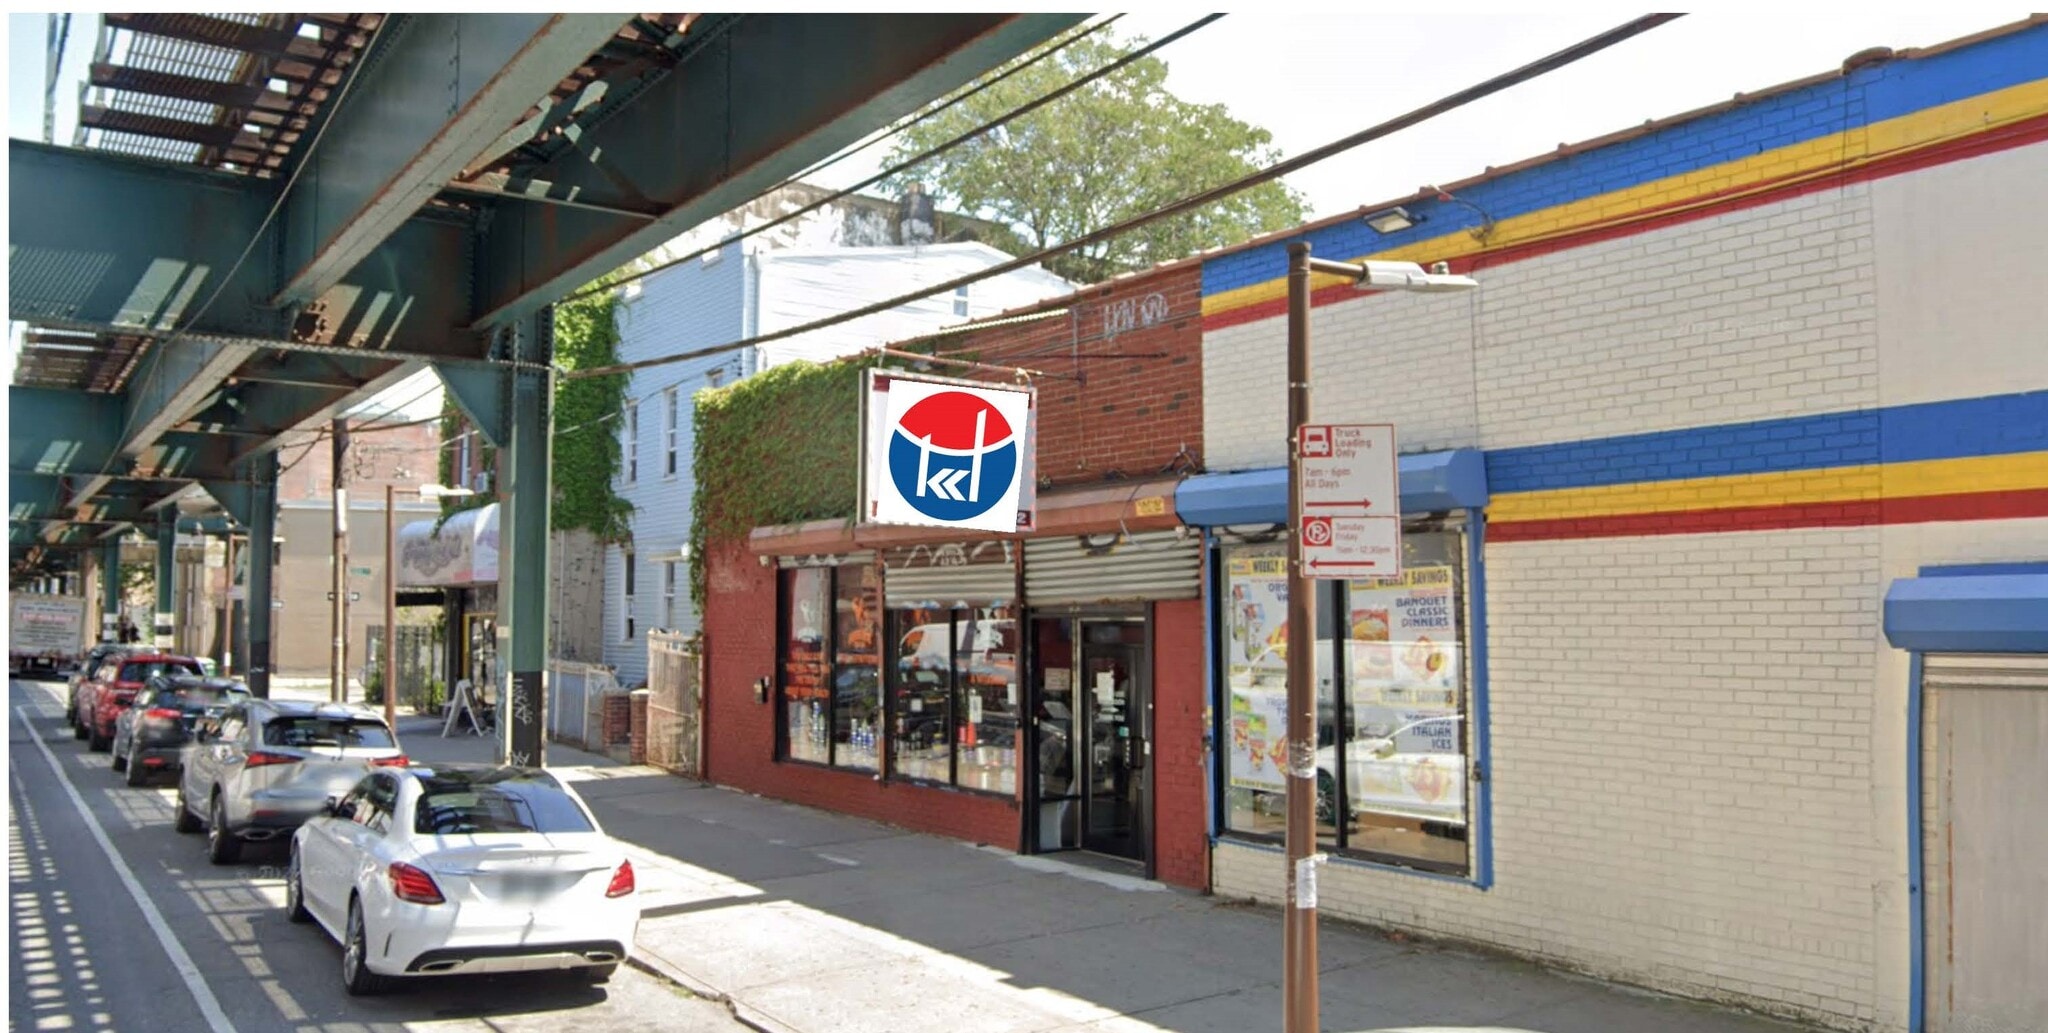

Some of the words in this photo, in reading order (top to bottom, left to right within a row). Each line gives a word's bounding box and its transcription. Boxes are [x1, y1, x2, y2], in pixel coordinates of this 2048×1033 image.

[1335, 429, 1361, 437] Truck
[1335, 439, 1372, 449] Loading
[1336, 449, 1357, 459] Only
[1305, 467, 1323, 477] 7am
[1331, 467, 1351, 478] 6pm
[1305, 480, 1317, 489] All
[1318, 480, 1340, 490] Days
[1411, 569, 1448, 585] SAVINGS
[1396, 596, 1448, 608] BANQUET
[1406, 607, 1449, 617] CLASSIC
[1402, 617, 1449, 628] DINNERS
[1412, 726, 1452, 738] ITALIAN
[1431, 739, 1452, 750] ICES
